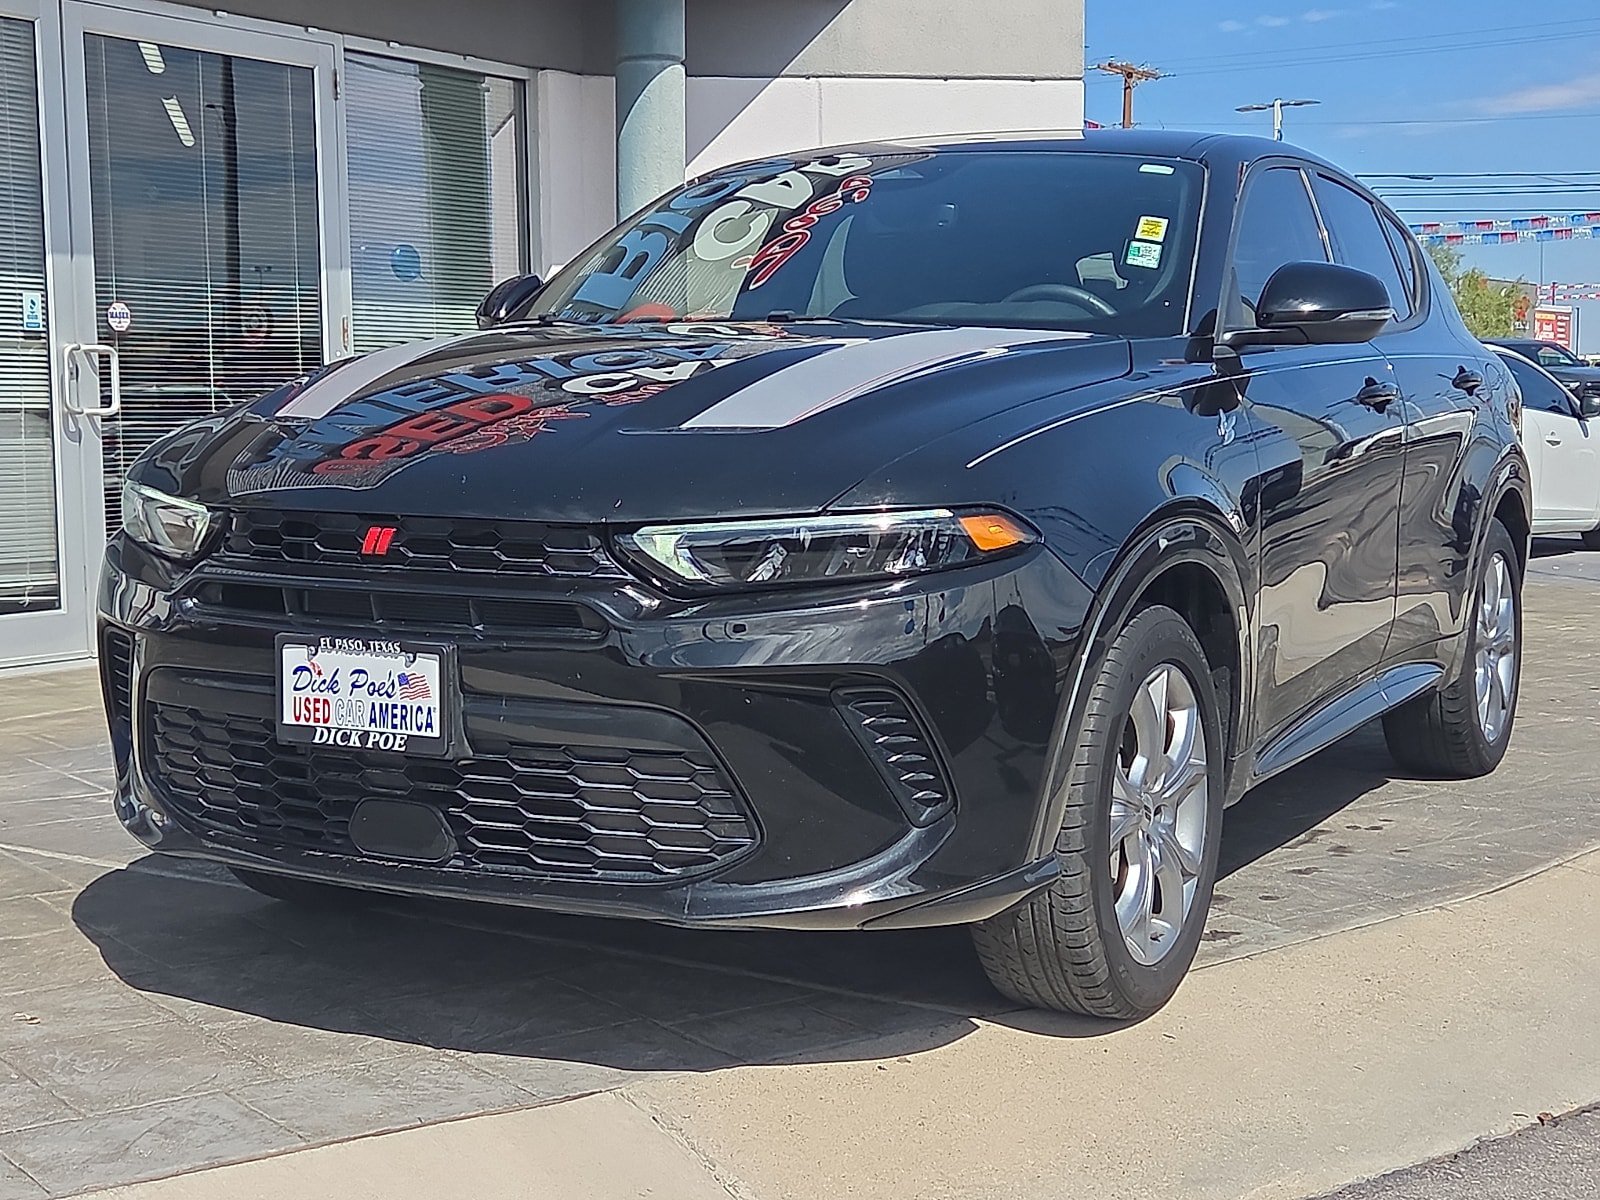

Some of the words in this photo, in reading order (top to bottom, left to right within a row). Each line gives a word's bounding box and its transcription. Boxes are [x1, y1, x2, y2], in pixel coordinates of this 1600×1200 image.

[320, 637, 333, 650] EL
[335, 638, 365, 652] PASO,
[368, 640, 401, 654] TEXAS
[292, 665, 341, 695] Dick
[349, 668, 397, 698] Poe's
[293, 696, 331, 725] USED
[334, 698, 365, 727] CAR
[368, 701, 434, 733] AMERICA
[312, 727, 364, 747] DICK
[365, 732, 408, 752] POE
